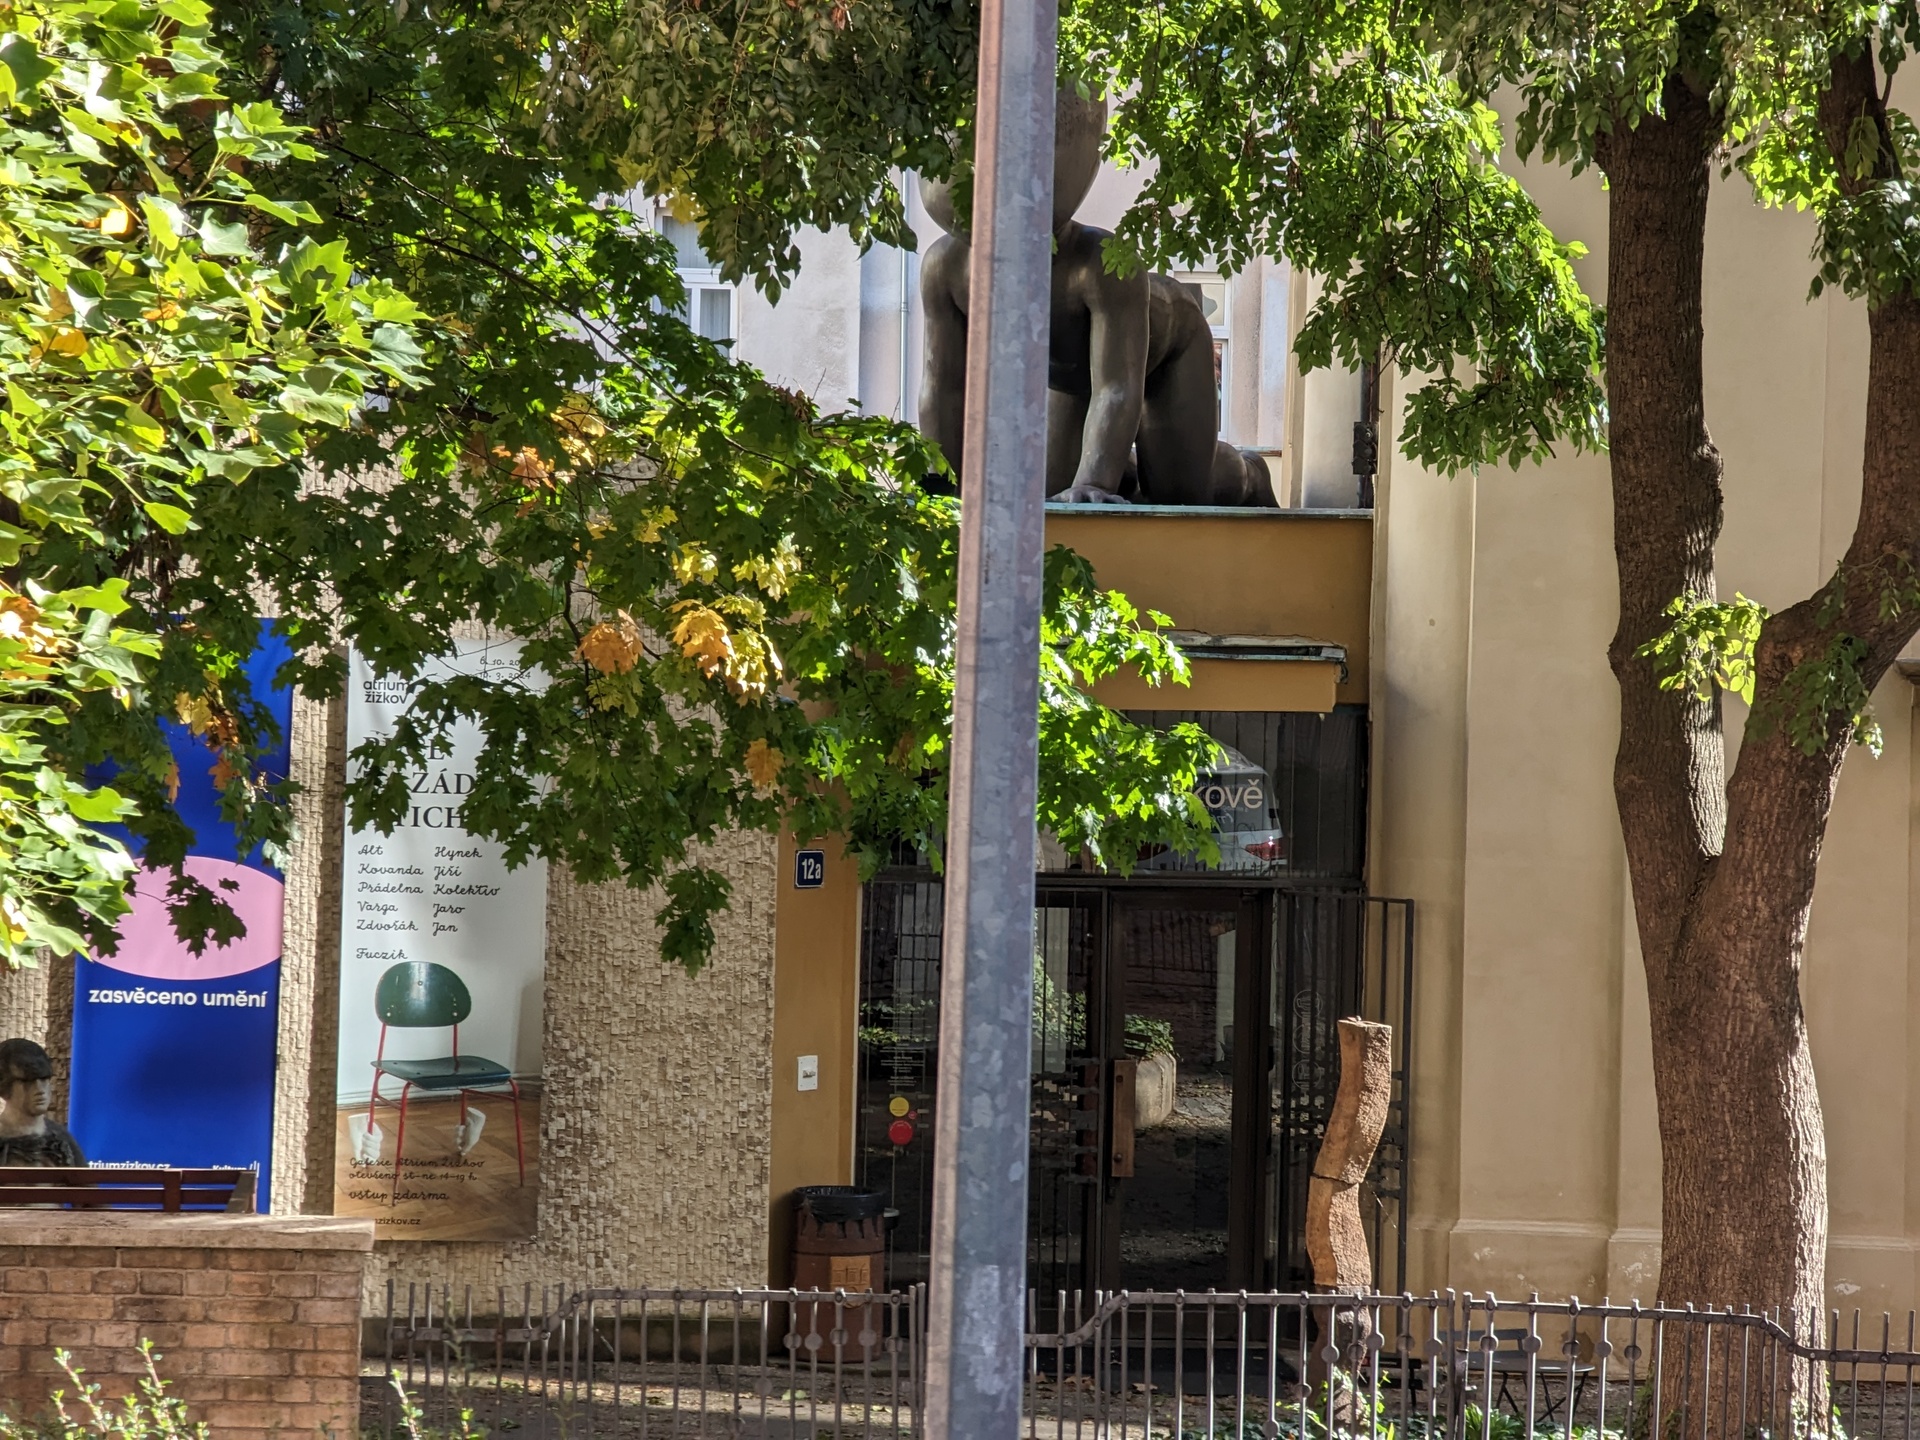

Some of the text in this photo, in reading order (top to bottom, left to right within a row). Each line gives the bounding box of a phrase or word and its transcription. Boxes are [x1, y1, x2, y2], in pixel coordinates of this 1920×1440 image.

[363, 679, 406, 691] atrium
[364, 691, 408, 704] žižkov
[358, 845, 482, 860] Alt Hynek
[357, 863, 462, 880] Kovanda Jiří
[801, 858, 821, 880] 12a
[357, 882, 500, 896] Prádelna Kolektiv
[357, 901, 465, 918] Varga Jaro
[356, 919, 458, 936] Zdvořák Jan
[356, 947, 408, 960] Fuczik
[89, 987, 268, 1008] zasvěceno umění
[349, 1170, 400, 1180] otevřeno
[349, 1189, 449, 1202] vstup zdarma
